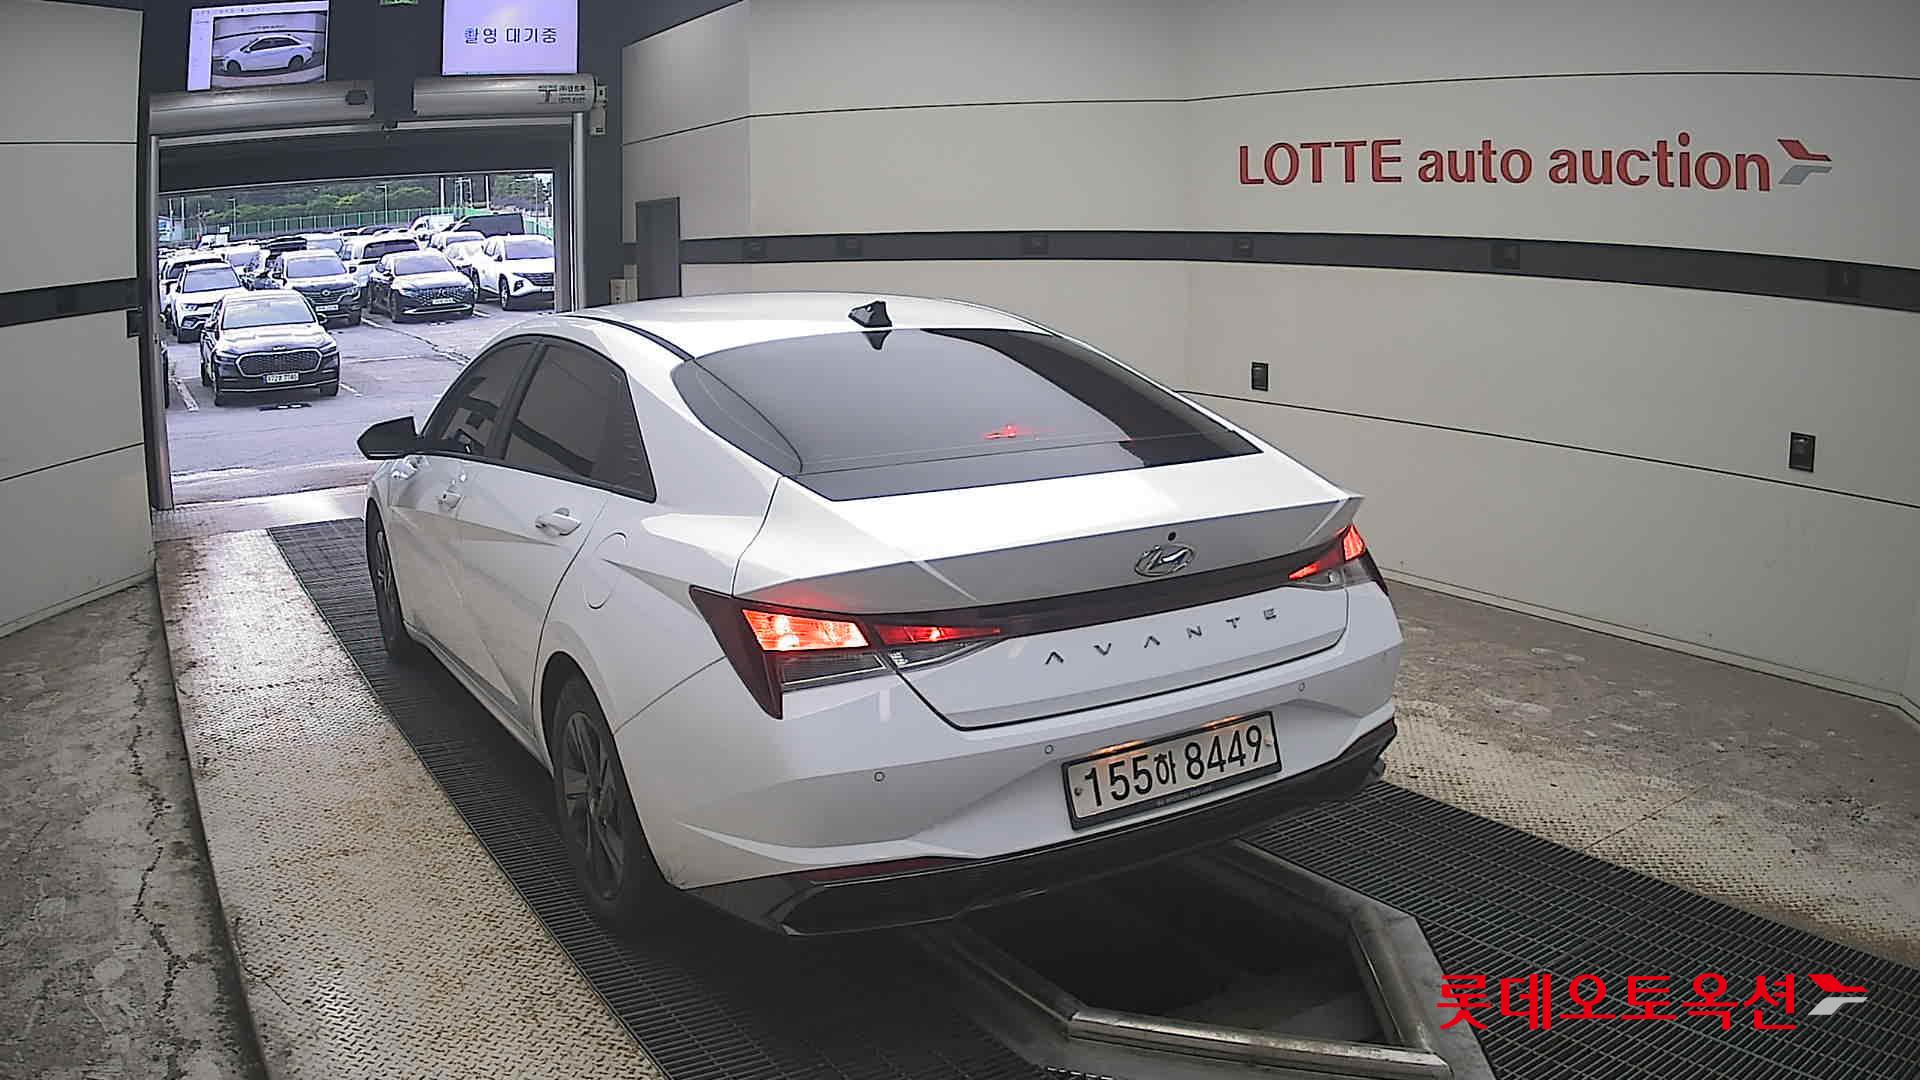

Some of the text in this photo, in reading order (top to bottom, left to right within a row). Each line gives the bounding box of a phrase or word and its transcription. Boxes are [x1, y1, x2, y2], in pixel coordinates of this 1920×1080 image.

[464, 26, 557, 44] 촬영 대기중
[1239, 132, 1772, 192] LOTTE auto auction
[1045, 607, 1278, 665] AVANTE
[1084, 725, 1263, 807] 155하 8449
